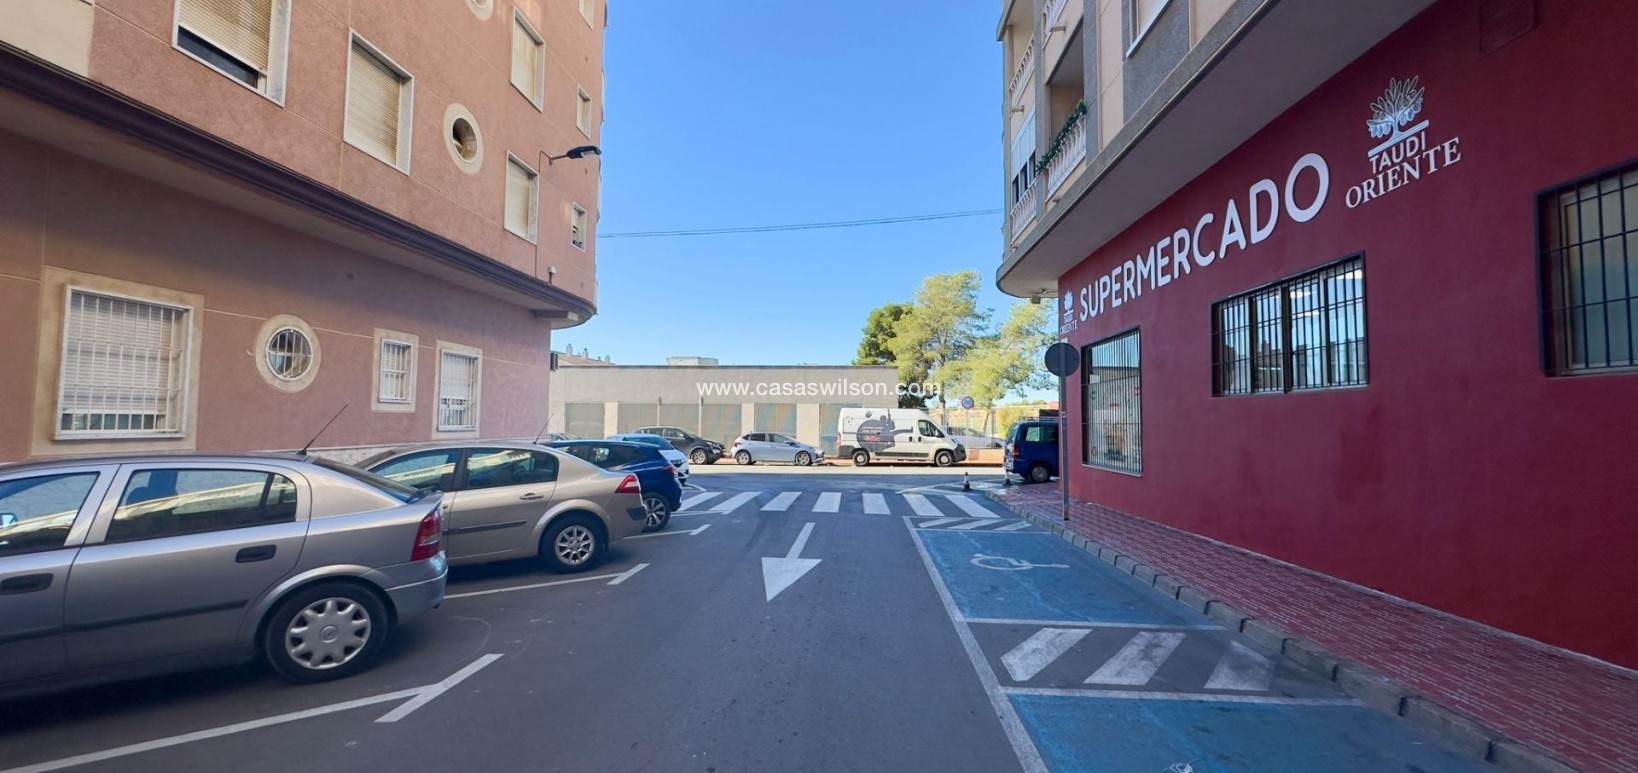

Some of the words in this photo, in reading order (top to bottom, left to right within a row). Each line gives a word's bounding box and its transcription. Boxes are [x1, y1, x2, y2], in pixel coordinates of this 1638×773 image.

[1345, 136, 1461, 208] ORIENTE
[1369, 131, 1426, 174] TAUDI
[1079, 152, 1330, 322] SUPERMERCADO
